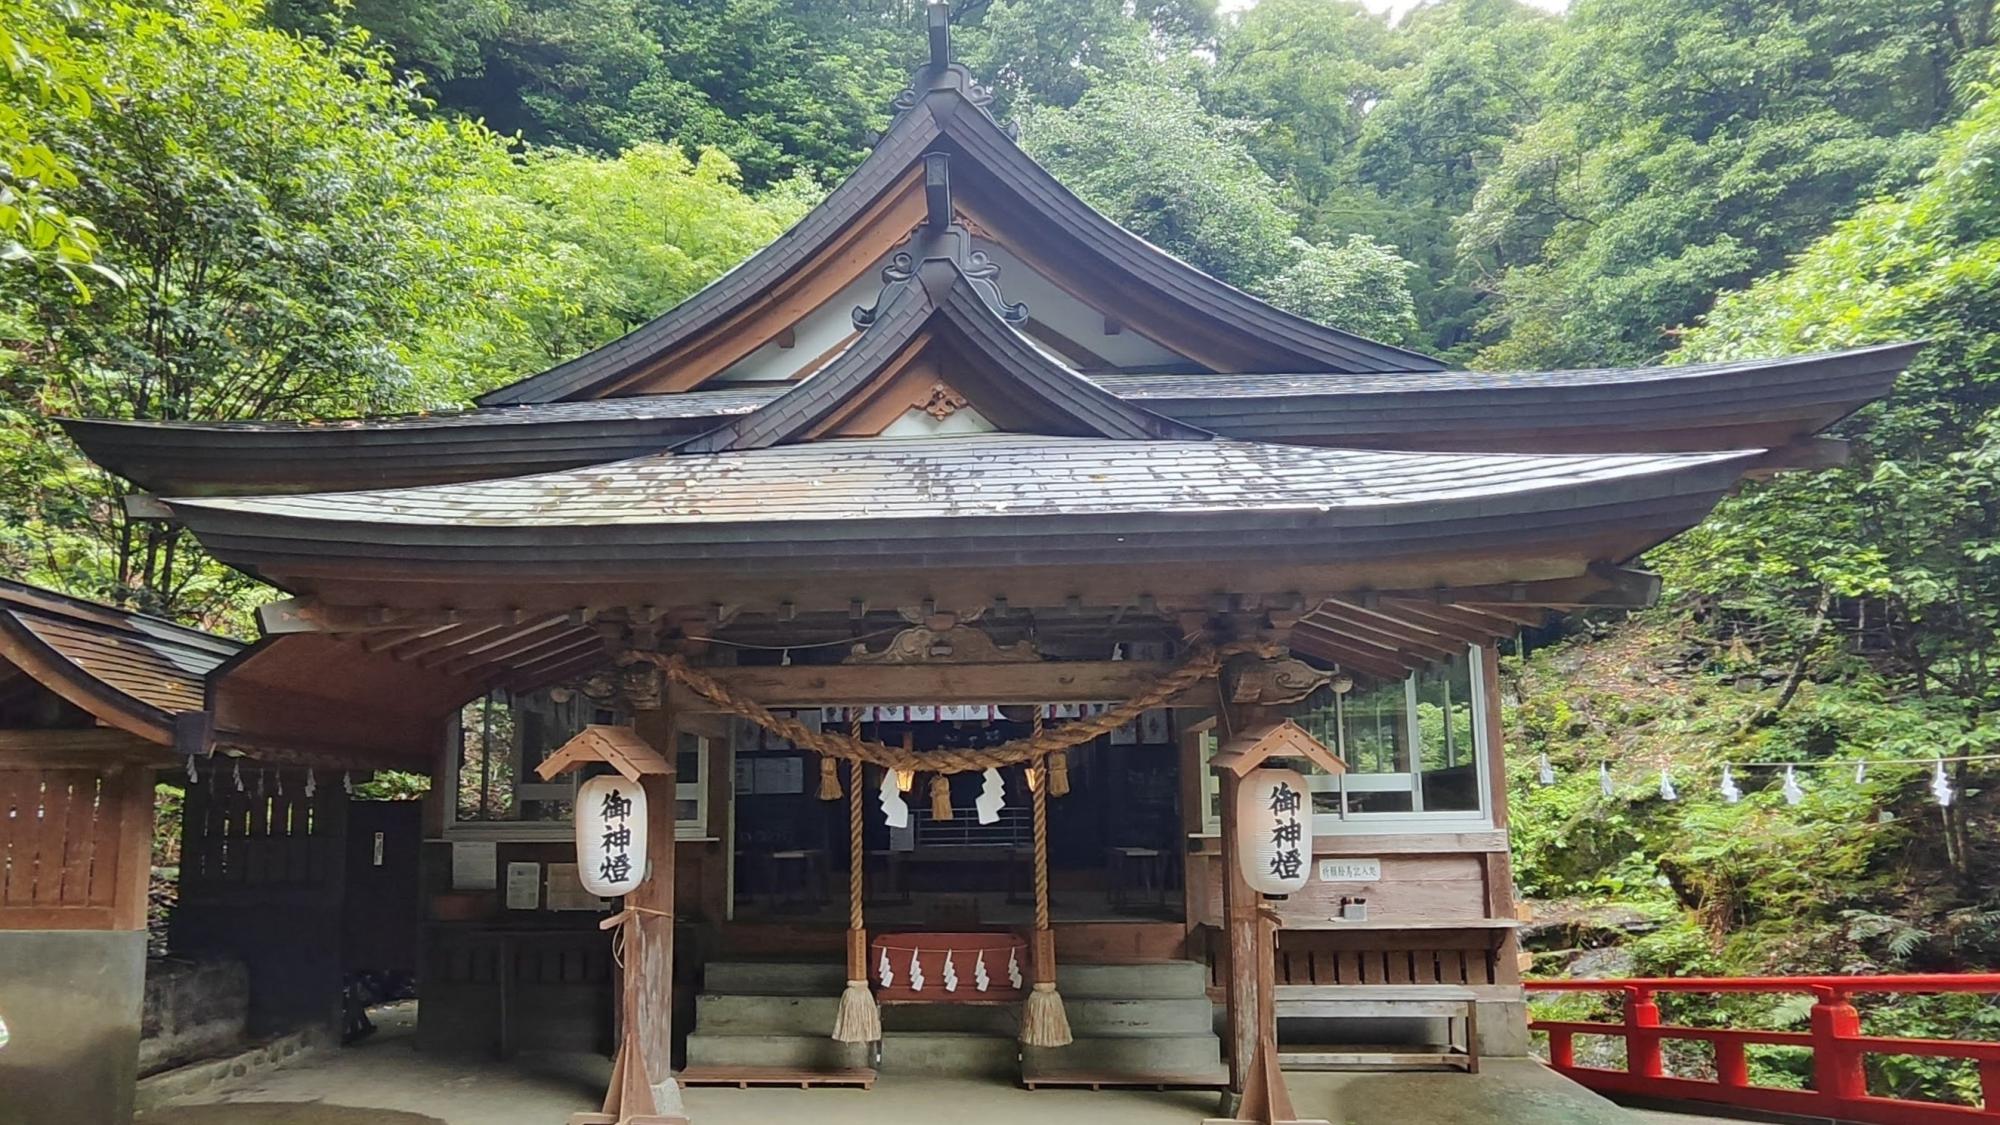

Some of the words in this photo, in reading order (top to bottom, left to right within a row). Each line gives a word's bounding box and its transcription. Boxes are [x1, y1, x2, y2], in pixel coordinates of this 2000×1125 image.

[600, 789, 632, 883] 御神燈
[1270, 782, 1302, 880] 御神燈
